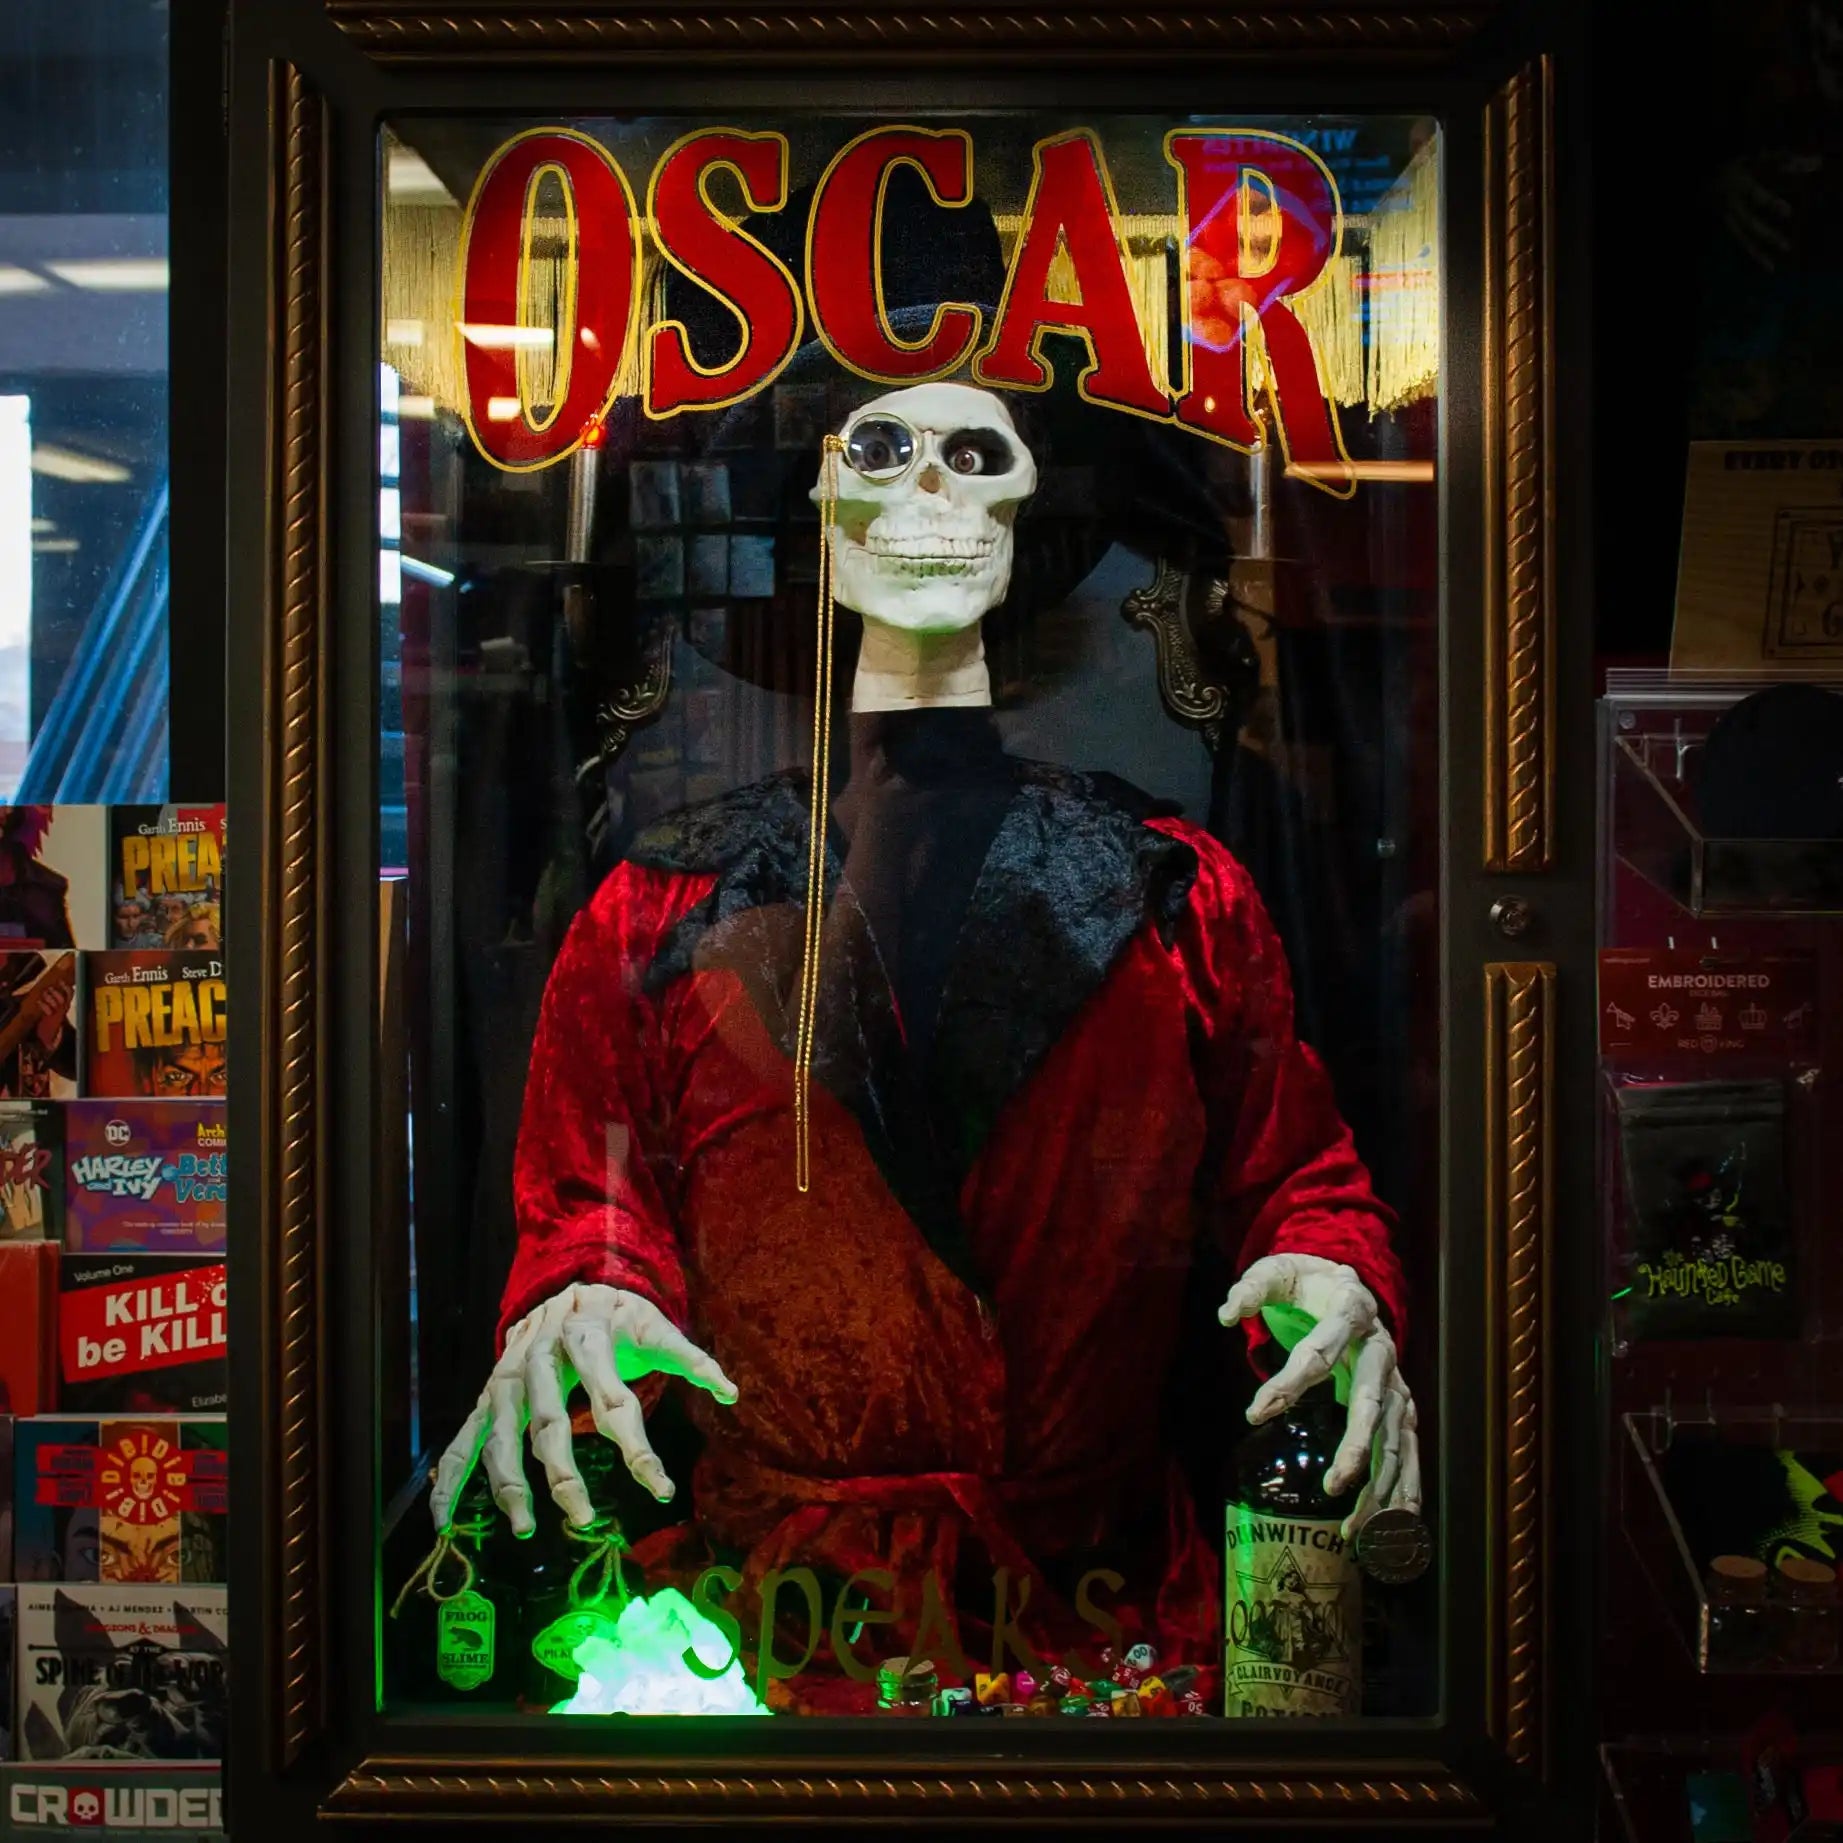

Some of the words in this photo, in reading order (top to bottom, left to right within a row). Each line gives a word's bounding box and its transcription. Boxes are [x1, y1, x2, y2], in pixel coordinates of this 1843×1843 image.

[456, 126, 1357, 500] OSCAR
[168, 817, 207, 834] Ennis
[121, 831, 227, 899] PREA
[105, 972, 131, 984] Garth
[132, 966, 169, 982] Ennis
[182, 966, 208, 981] Steve
[1648, 974, 1771, 988] EMBROIDERED
[95, 979, 227, 1053] PREAC
[106, 1124, 130, 1142] DC
[70, 1154, 164, 1185] HARLEY
[111, 1175, 163, 1200] IVY
[73, 1267, 111, 1284] Volume
[112, 1263, 136, 1277] One
[105, 1282, 200, 1328] KILL
[77, 1336, 127, 1369] be
[139, 1311, 227, 1360] KILL
[442, 1653, 489, 1665] SLIME
[1236, 1664, 1342, 1694] CLAIRVOYANCE
